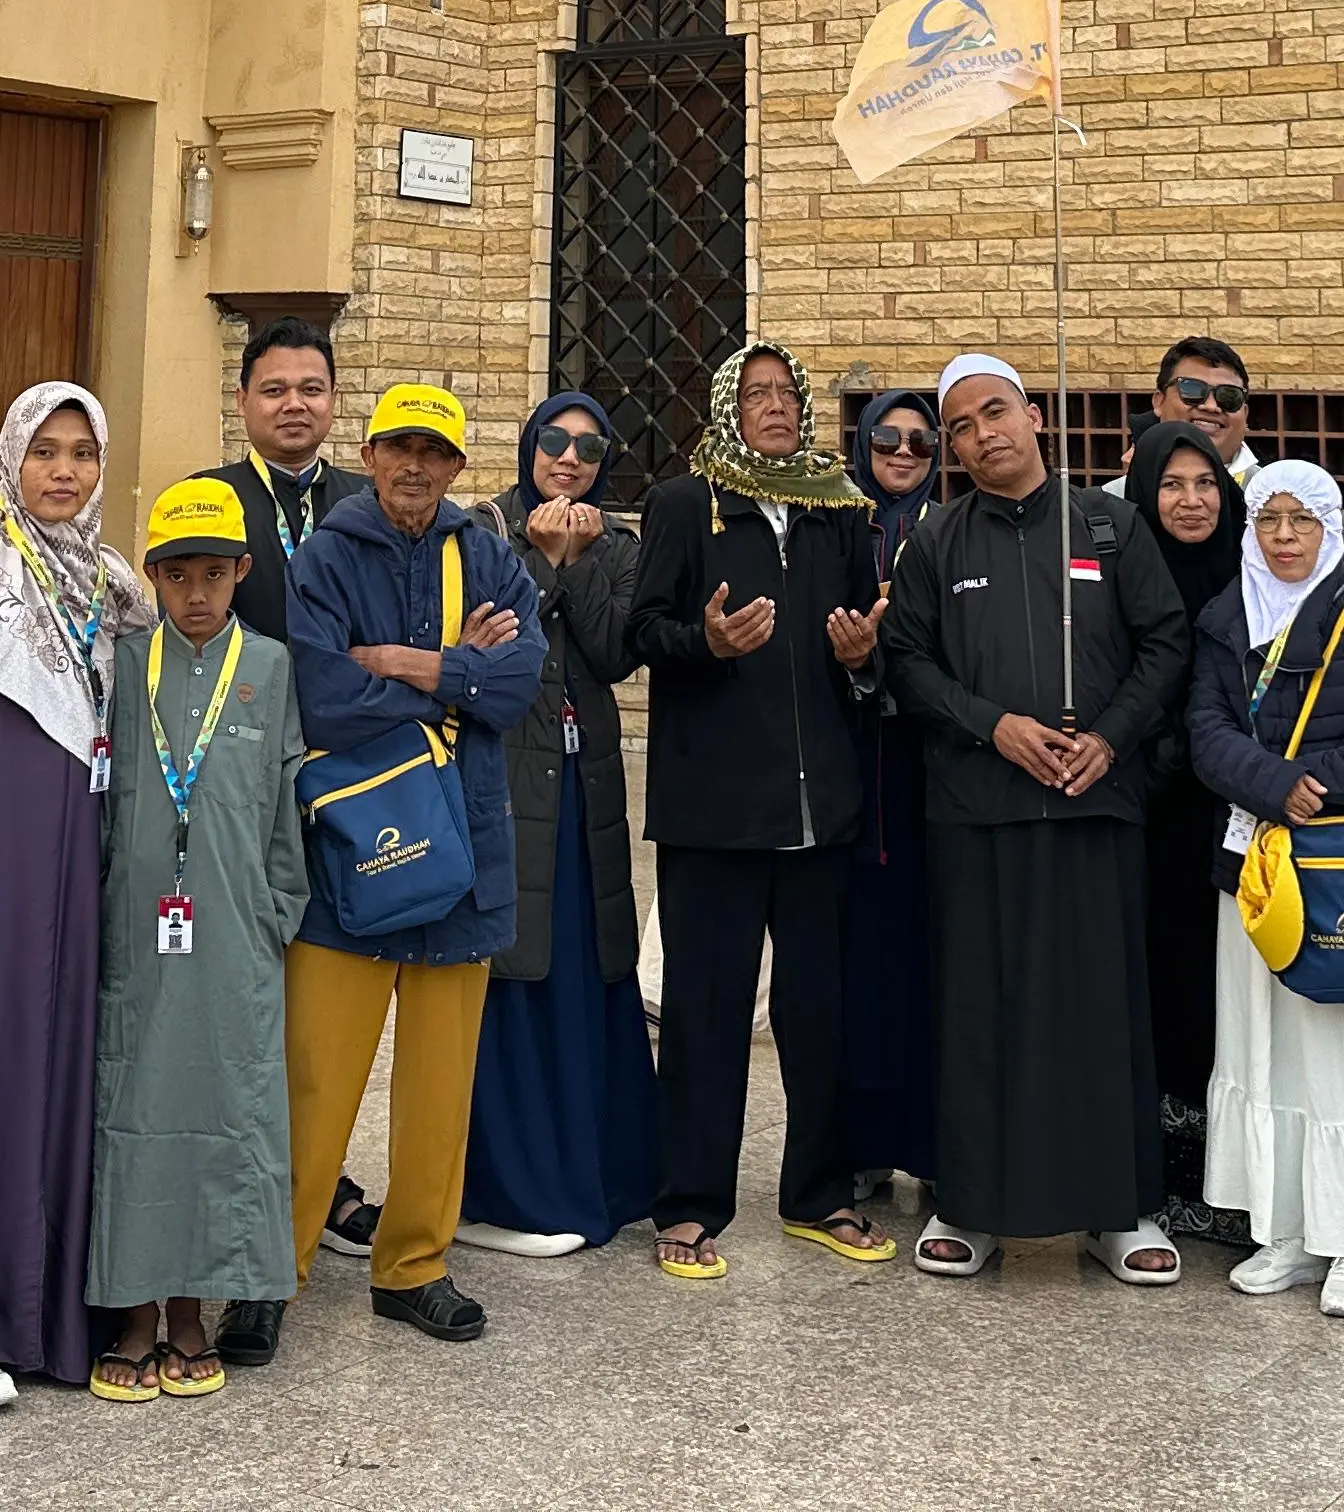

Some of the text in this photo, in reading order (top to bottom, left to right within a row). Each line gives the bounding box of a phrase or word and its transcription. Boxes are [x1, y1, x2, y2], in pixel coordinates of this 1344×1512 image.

[963, 577, 989, 589] MALIK
[356, 838, 431, 872] CAHAYA RAUDHAH
[1310, 934, 1344, 944] CAHAYA
